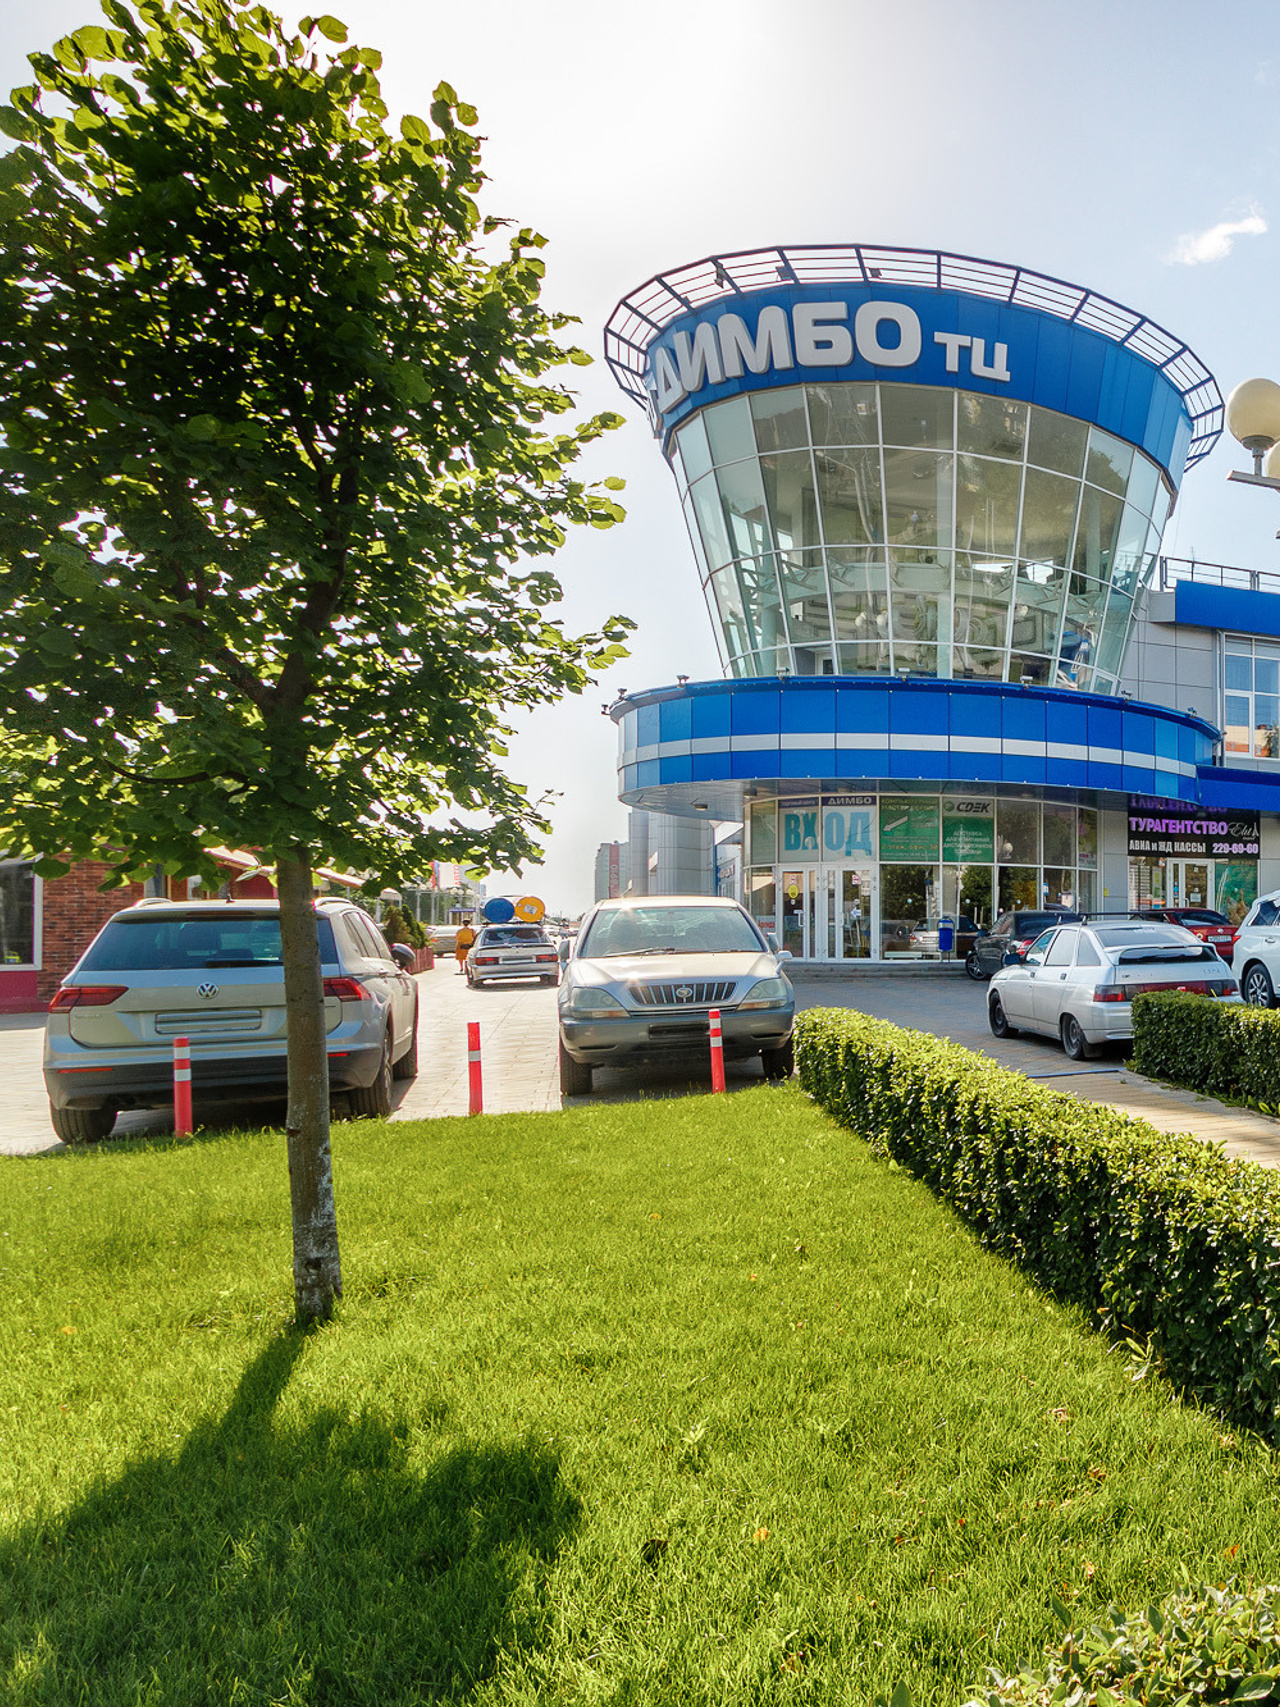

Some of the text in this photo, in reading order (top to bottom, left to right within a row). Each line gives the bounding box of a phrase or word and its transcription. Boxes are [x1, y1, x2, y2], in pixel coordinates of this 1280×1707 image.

[655, 301, 923, 415] ДИМБО
[828, 796, 872, 805] ДИМБО
[956, 801, 991, 813] CDEK
[1128, 817, 1229, 835] ТУРАГЕНТСТВО
[784, 811, 872, 857] ВХОД
[1129, 840, 1150, 851] АВИА
[1158, 841, 1173, 853] ЖД
[1174, 841, 1206, 853] КАССЫ
